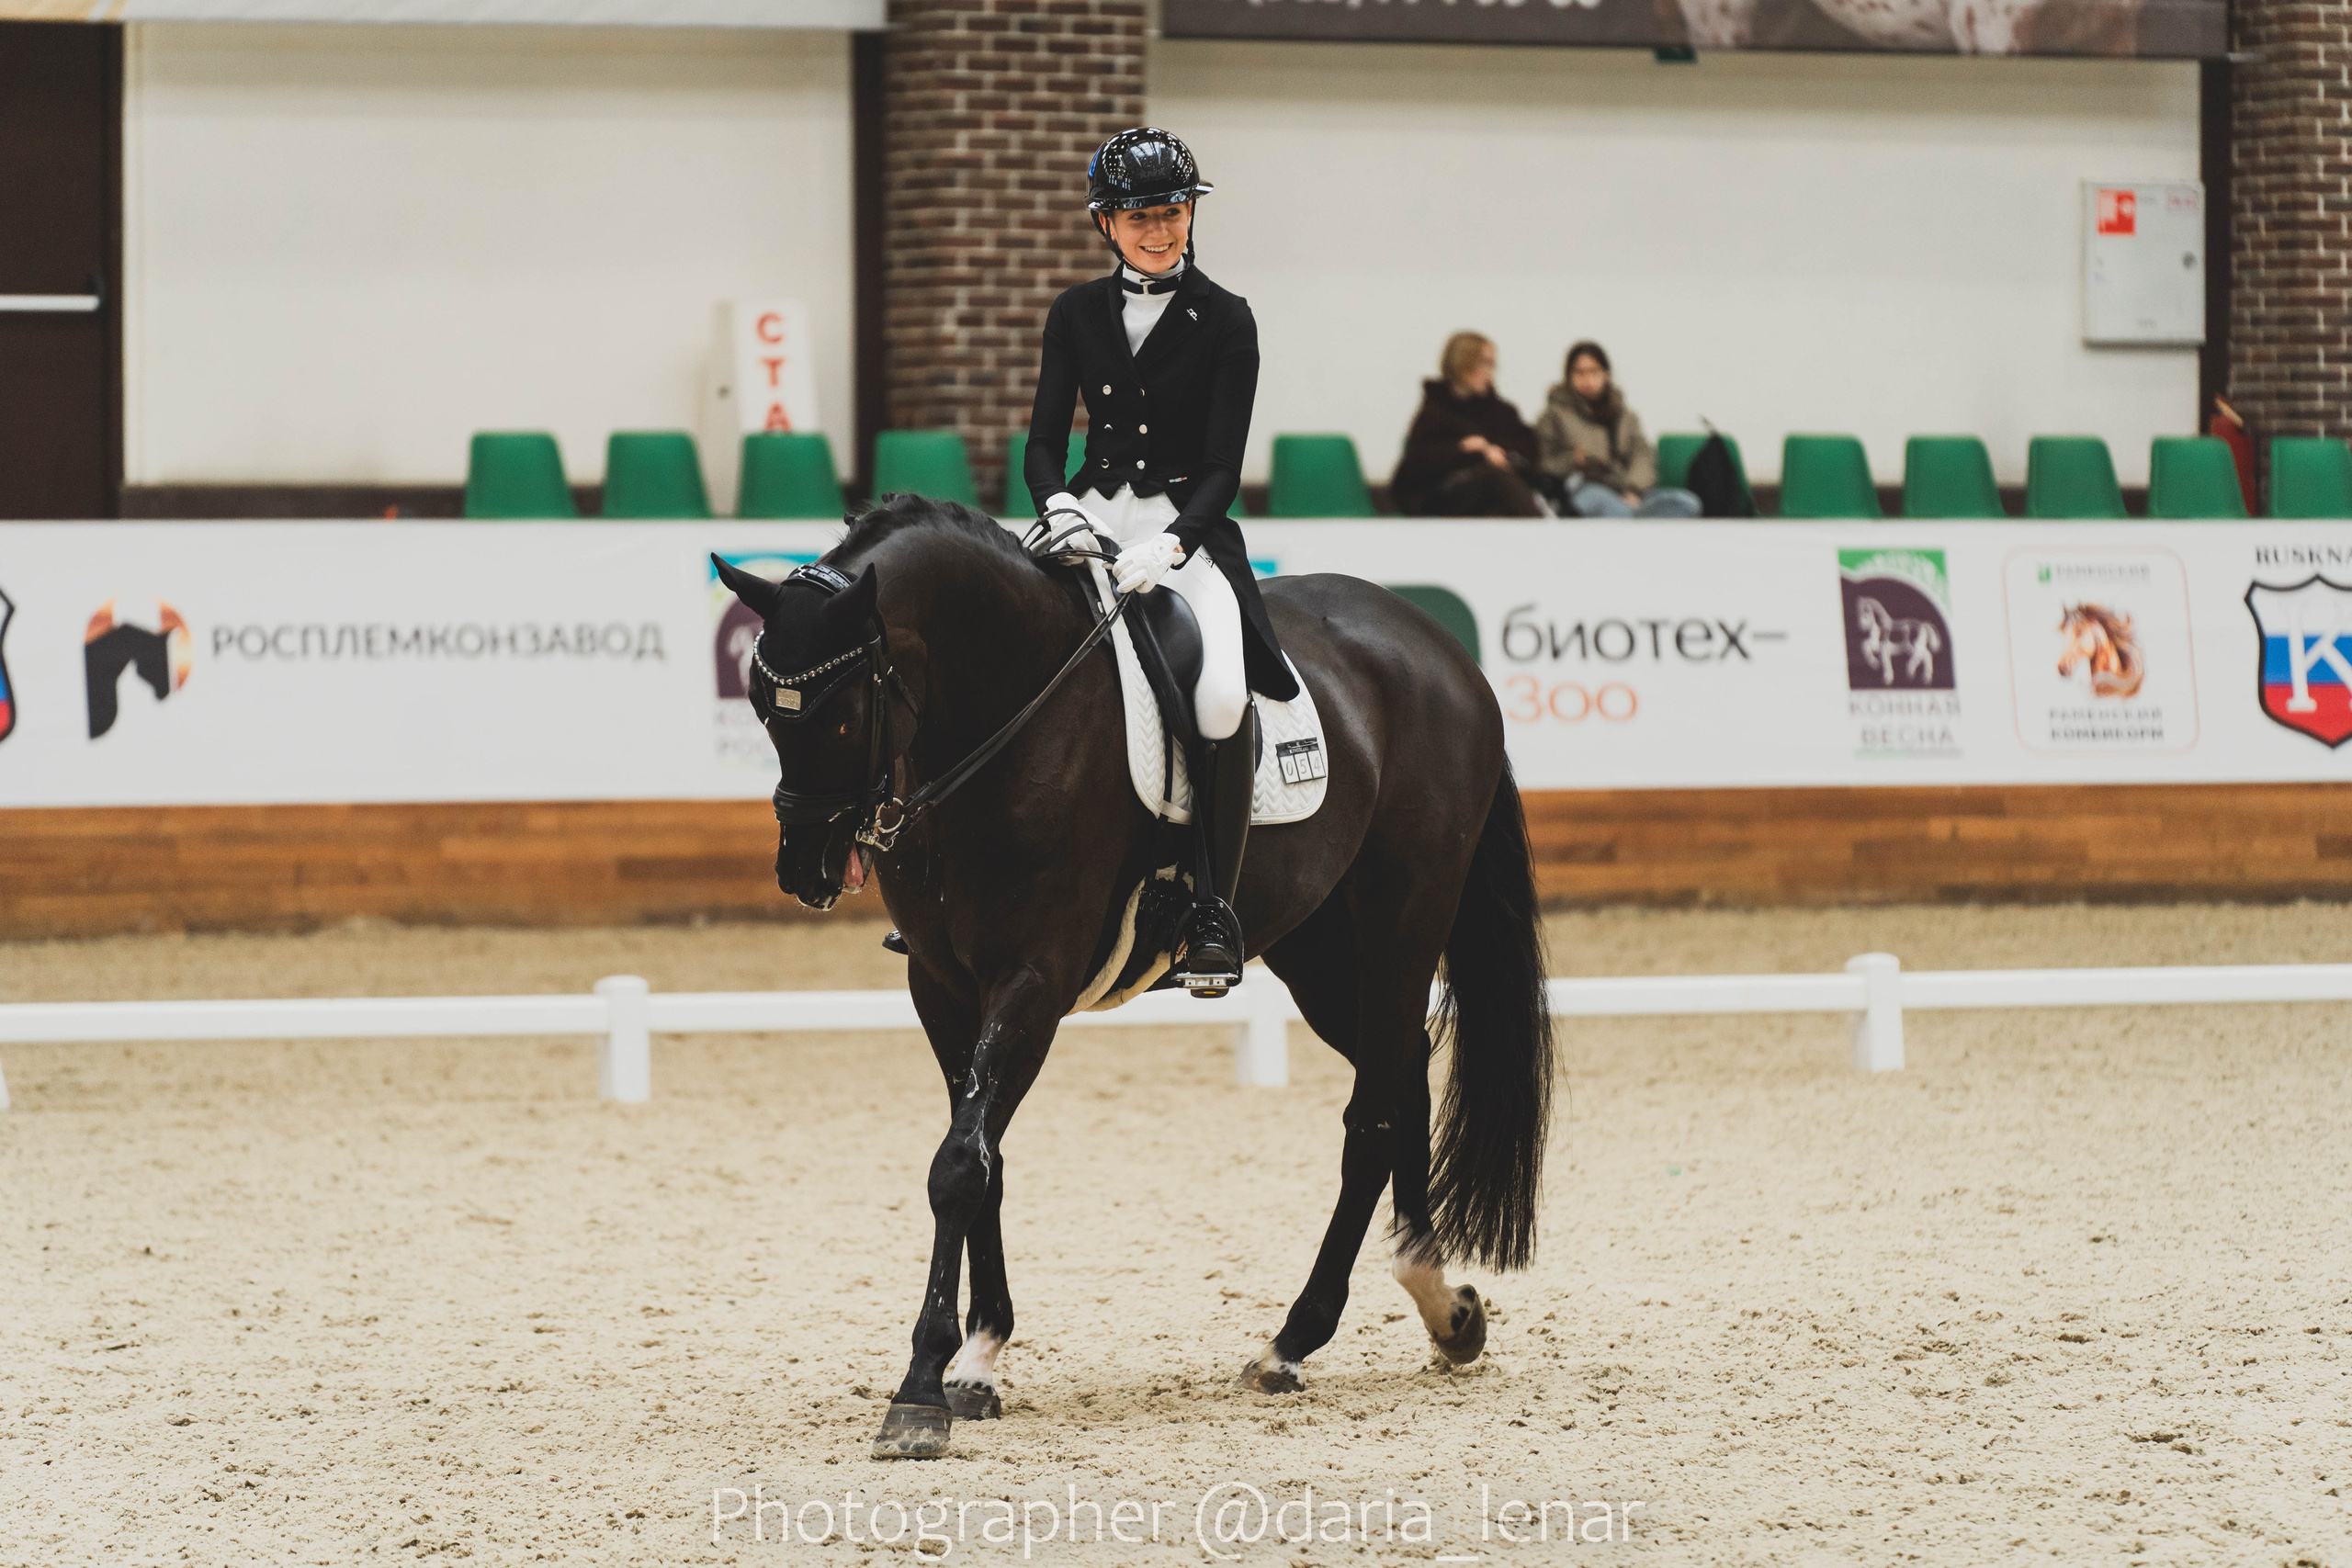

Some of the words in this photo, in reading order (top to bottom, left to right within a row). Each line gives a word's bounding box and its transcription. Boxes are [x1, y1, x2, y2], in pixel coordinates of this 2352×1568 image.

[212, 622, 665, 662] РОСПЛЕМКОНЗАВОД
[1848, 695, 1962, 716] КОННАЯ
[1861, 724, 1955, 745] ВЕСНА
[1286, 757, 1321, 776] 054
